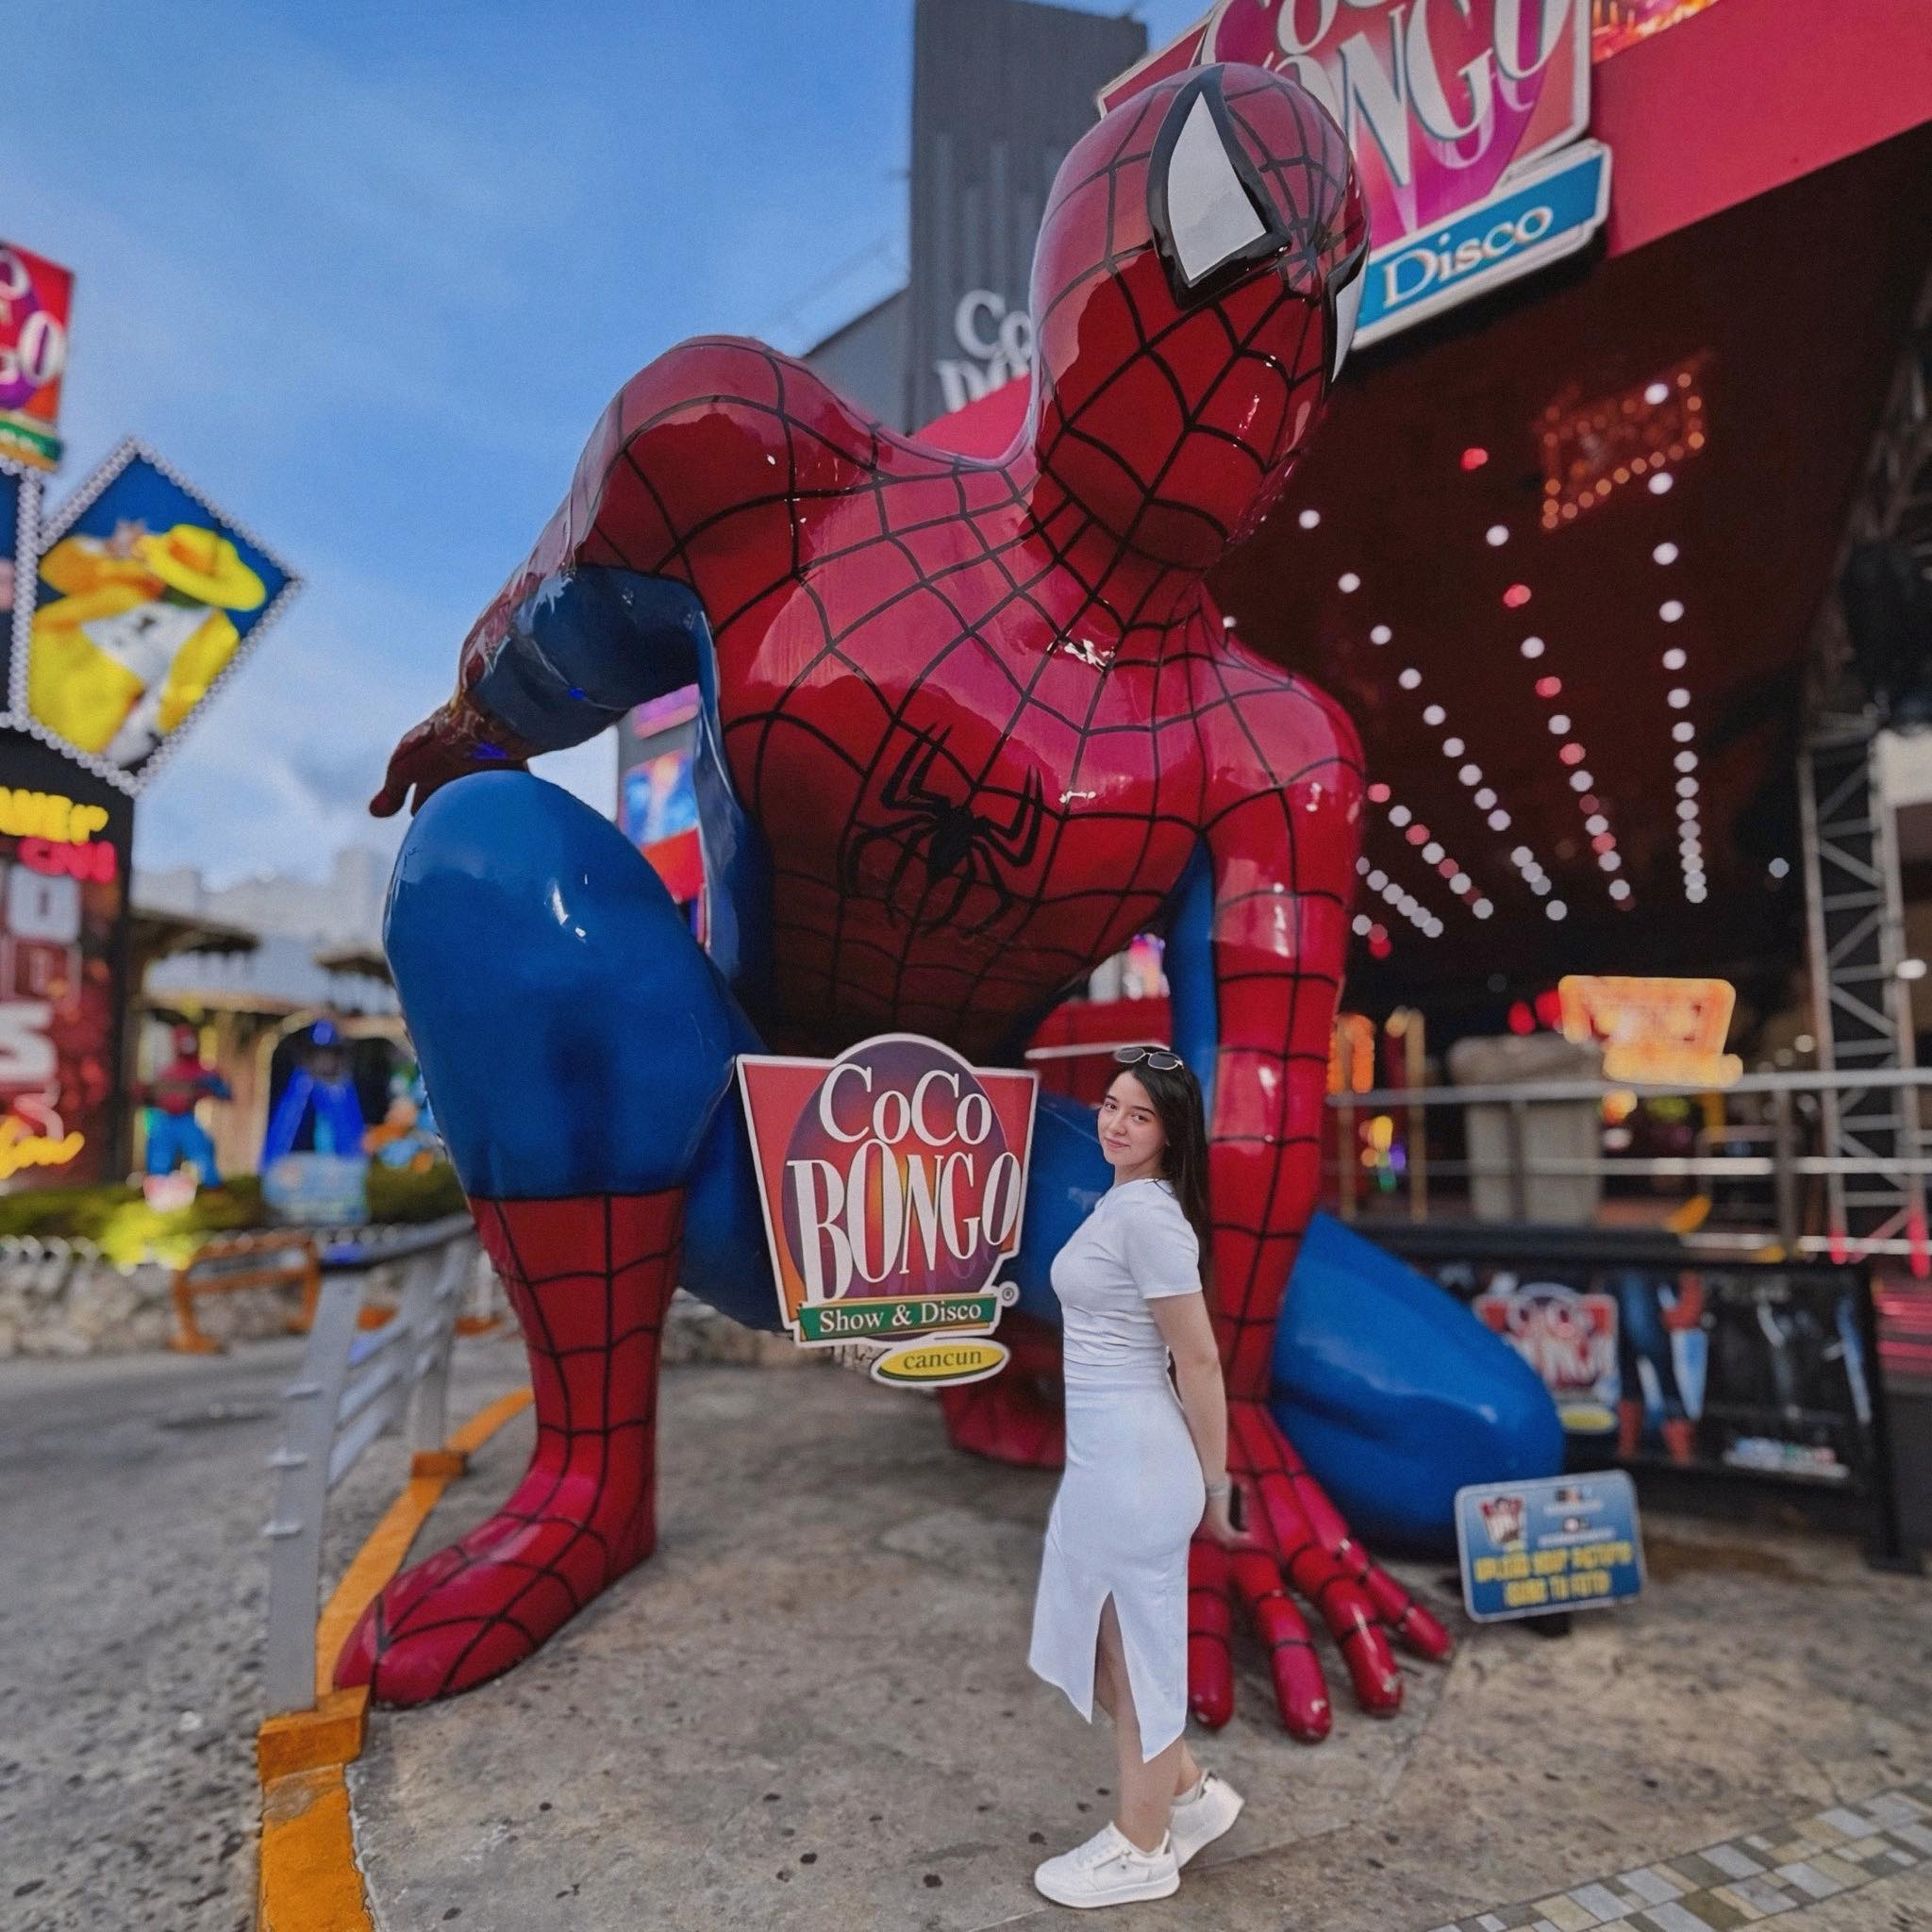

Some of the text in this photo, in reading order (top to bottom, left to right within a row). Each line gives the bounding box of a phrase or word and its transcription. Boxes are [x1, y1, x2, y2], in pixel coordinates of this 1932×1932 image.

[1270, 0, 1572, 188] NGO
[1383, 206, 1553, 308] Disco
[819, 1062, 992, 1146] CoCo
[786, 1138, 1022, 1305] BONGO
[819, 1301, 982, 1334] Show & Disco
[903, 1347, 983, 1371] cancun
